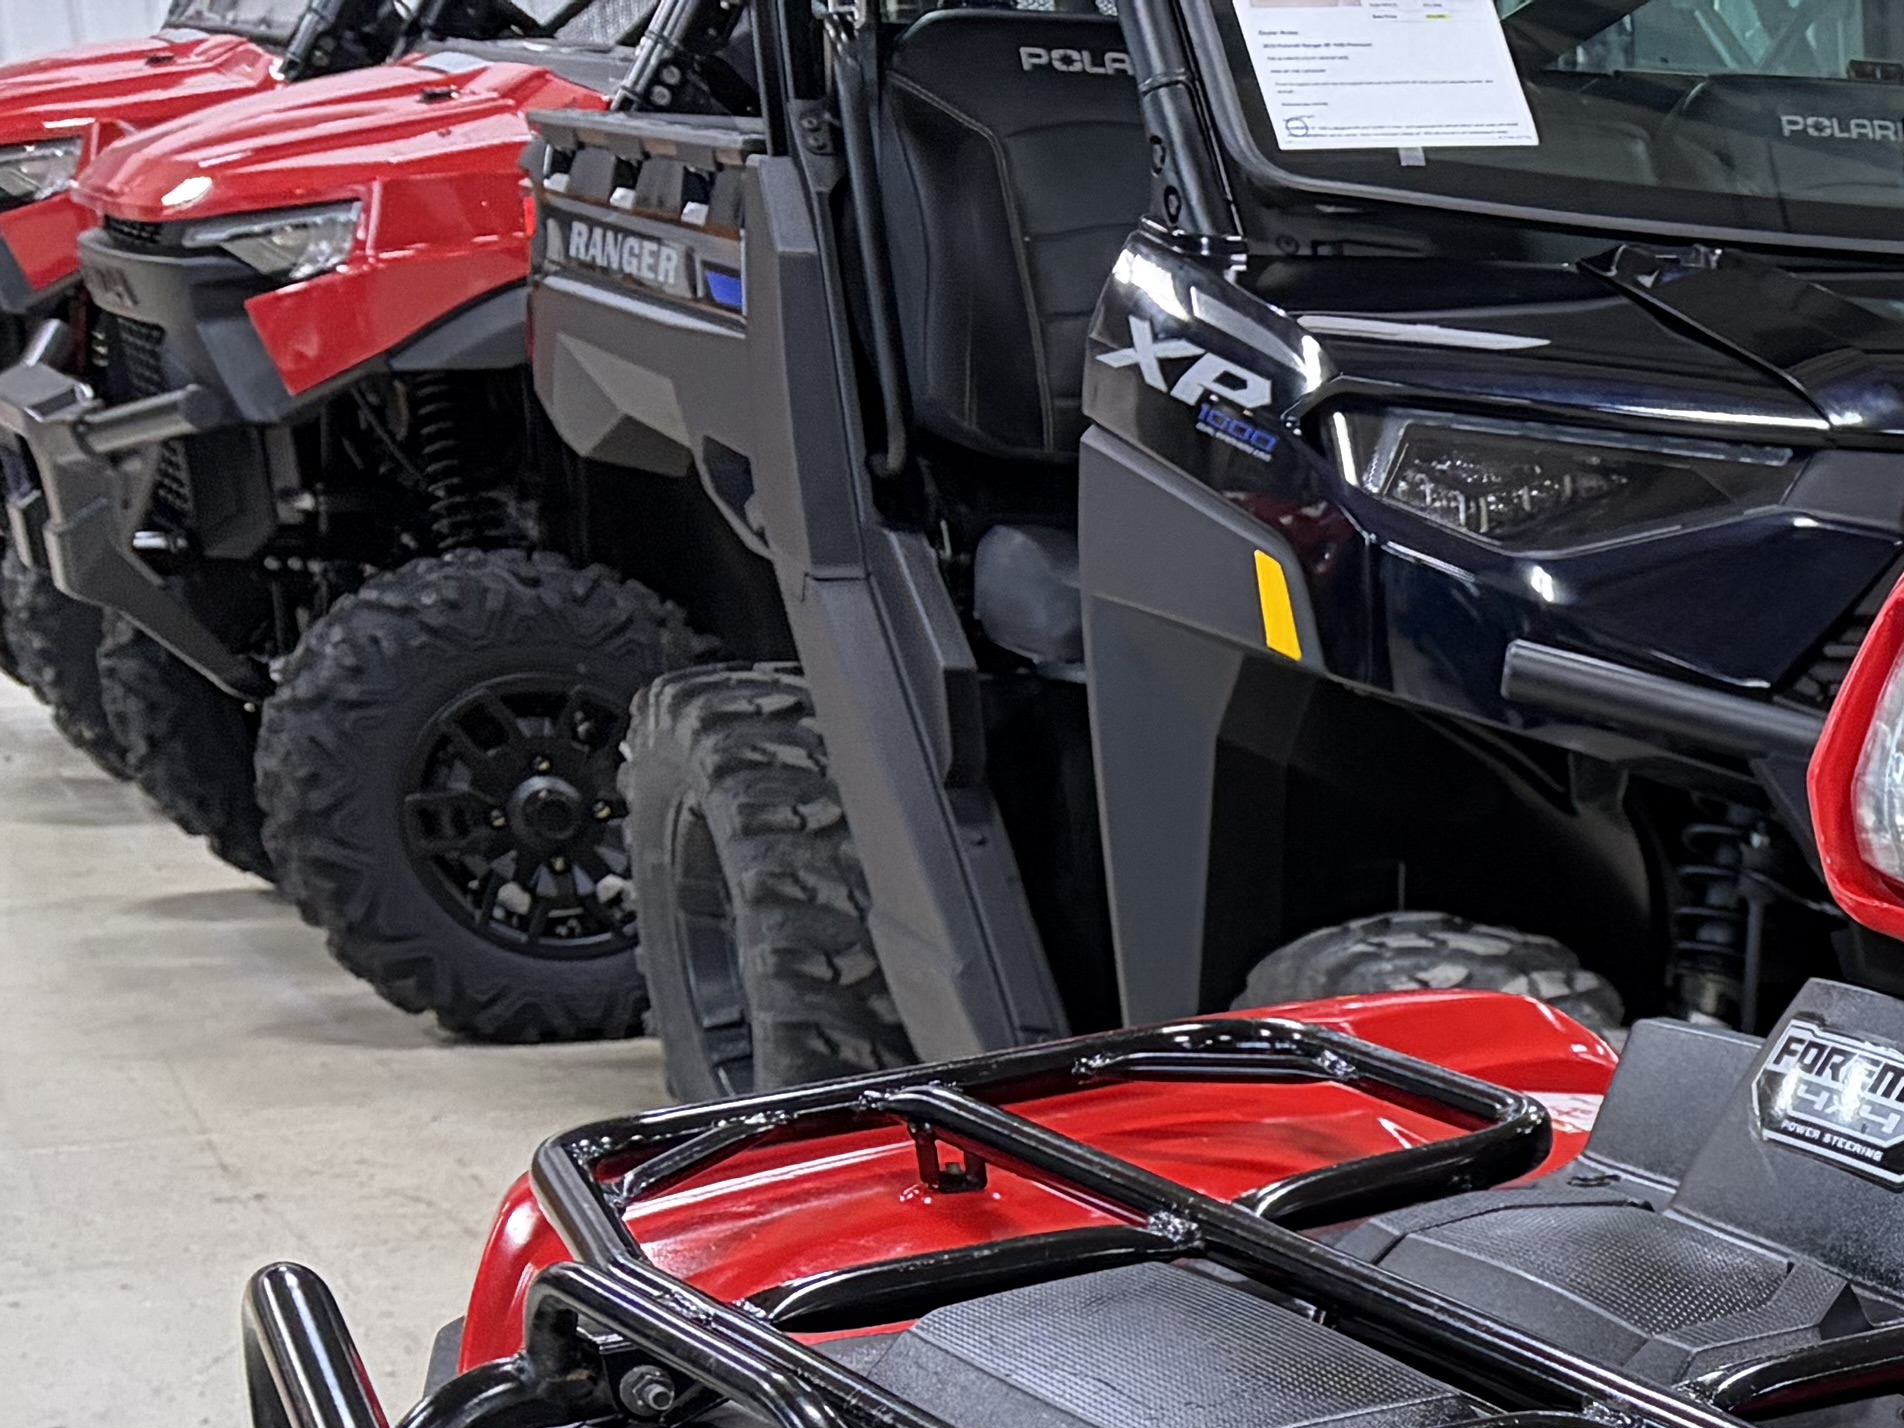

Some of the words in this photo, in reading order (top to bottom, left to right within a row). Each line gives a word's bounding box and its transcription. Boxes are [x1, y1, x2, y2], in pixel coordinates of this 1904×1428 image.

[1019, 46, 1134, 75] POLA
[1780, 115, 1904, 141] POLARI
[568, 221, 679, 284] RANGER
[1096, 314, 1272, 409] XP
[1199, 403, 1278, 451] 1000
[1781, 1119, 1821, 1141] POWER
[1822, 1131, 1884, 1162] STEERING
